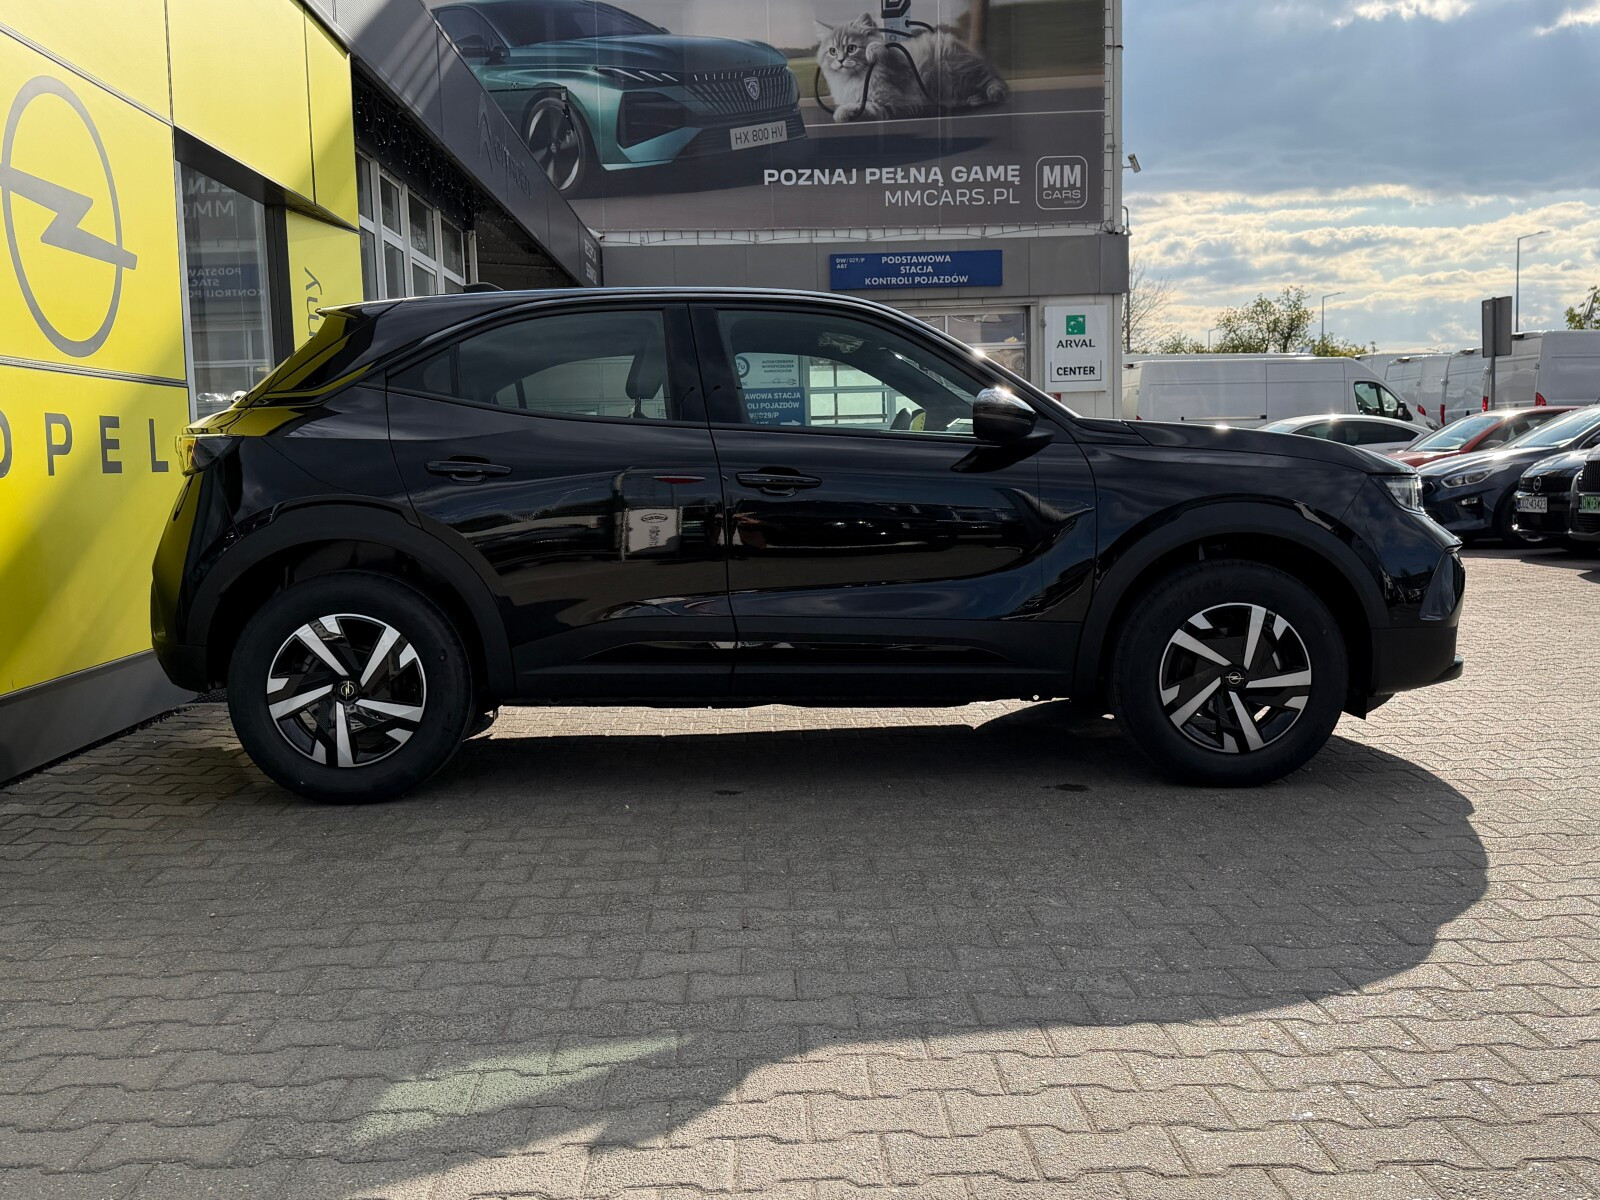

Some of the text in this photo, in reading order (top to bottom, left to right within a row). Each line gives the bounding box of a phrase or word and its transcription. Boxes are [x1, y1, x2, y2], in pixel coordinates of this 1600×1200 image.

[734, 126, 784, 145] HX 800 HV
[763, 164, 1021, 187] POZNAJ PEŁNĄ GAMĘ
[1042, 164, 1081, 188] MM
[884, 187, 1021, 206] MMCARS.PL
[1042, 189, 1081, 200] CARS
[881, 254, 952, 264] PODSTAWOWA
[900, 265, 934, 274] STACJA
[864, 273, 969, 286] KONTROLI POJAZDÓW
[1056, 338, 1096, 349] ARVAL
[1056, 366, 1096, 376] CENTER
[744, 392, 773, 400] AWOWA
[760, 401, 800, 409] POJAZDÓW
